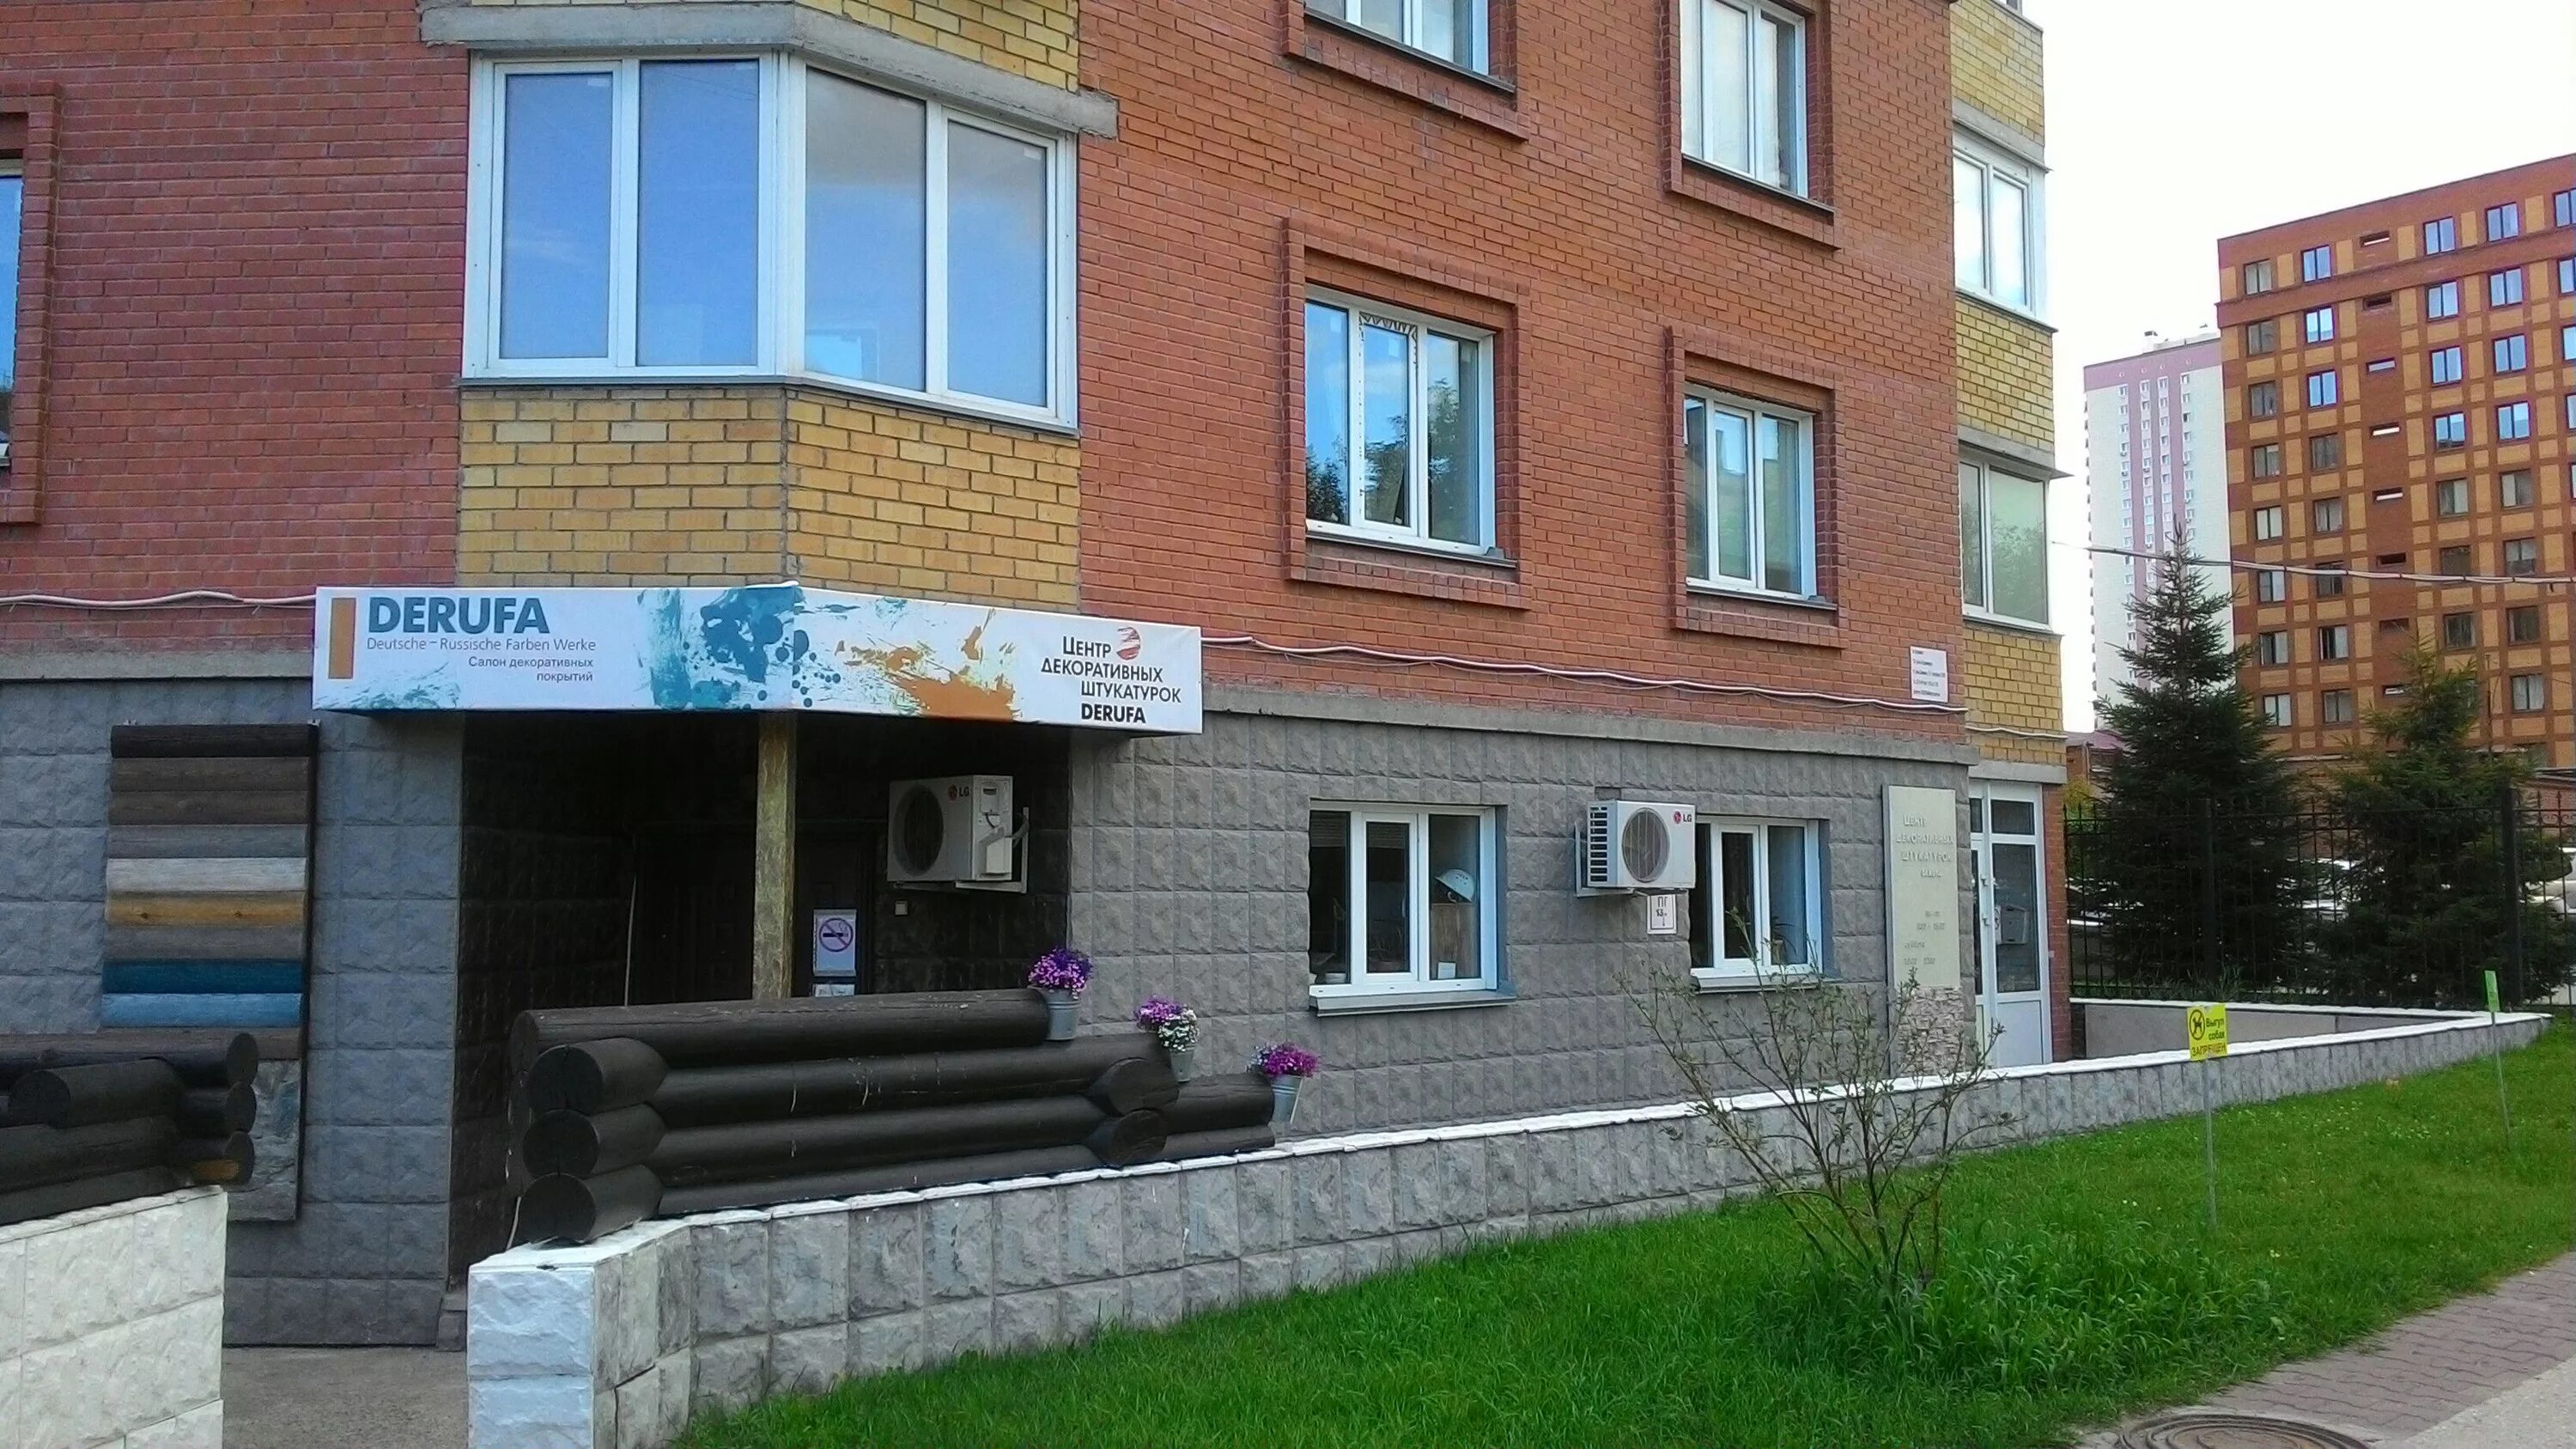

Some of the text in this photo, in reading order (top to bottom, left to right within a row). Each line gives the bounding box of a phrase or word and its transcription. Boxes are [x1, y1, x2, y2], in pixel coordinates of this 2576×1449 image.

[368, 596, 550, 635] DERUFA
[367, 637, 427, 650] Deutsche
[440, 637, 501, 651] Russische
[505, 638, 550, 651] Farben
[553, 638, 597, 651] Werke
[468, 656, 594, 669] Салон декоративных
[536, 671, 593, 683] покрытий
[1041, 657, 1163, 683] ДЕКОРАТИВНЫХ
[1081, 680, 1182, 703] ШТУКАТУРОК
[1081, 703, 1146, 724] DERUFA
[958, 786, 970, 798] LG
[1682, 813, 1692, 823] LG
